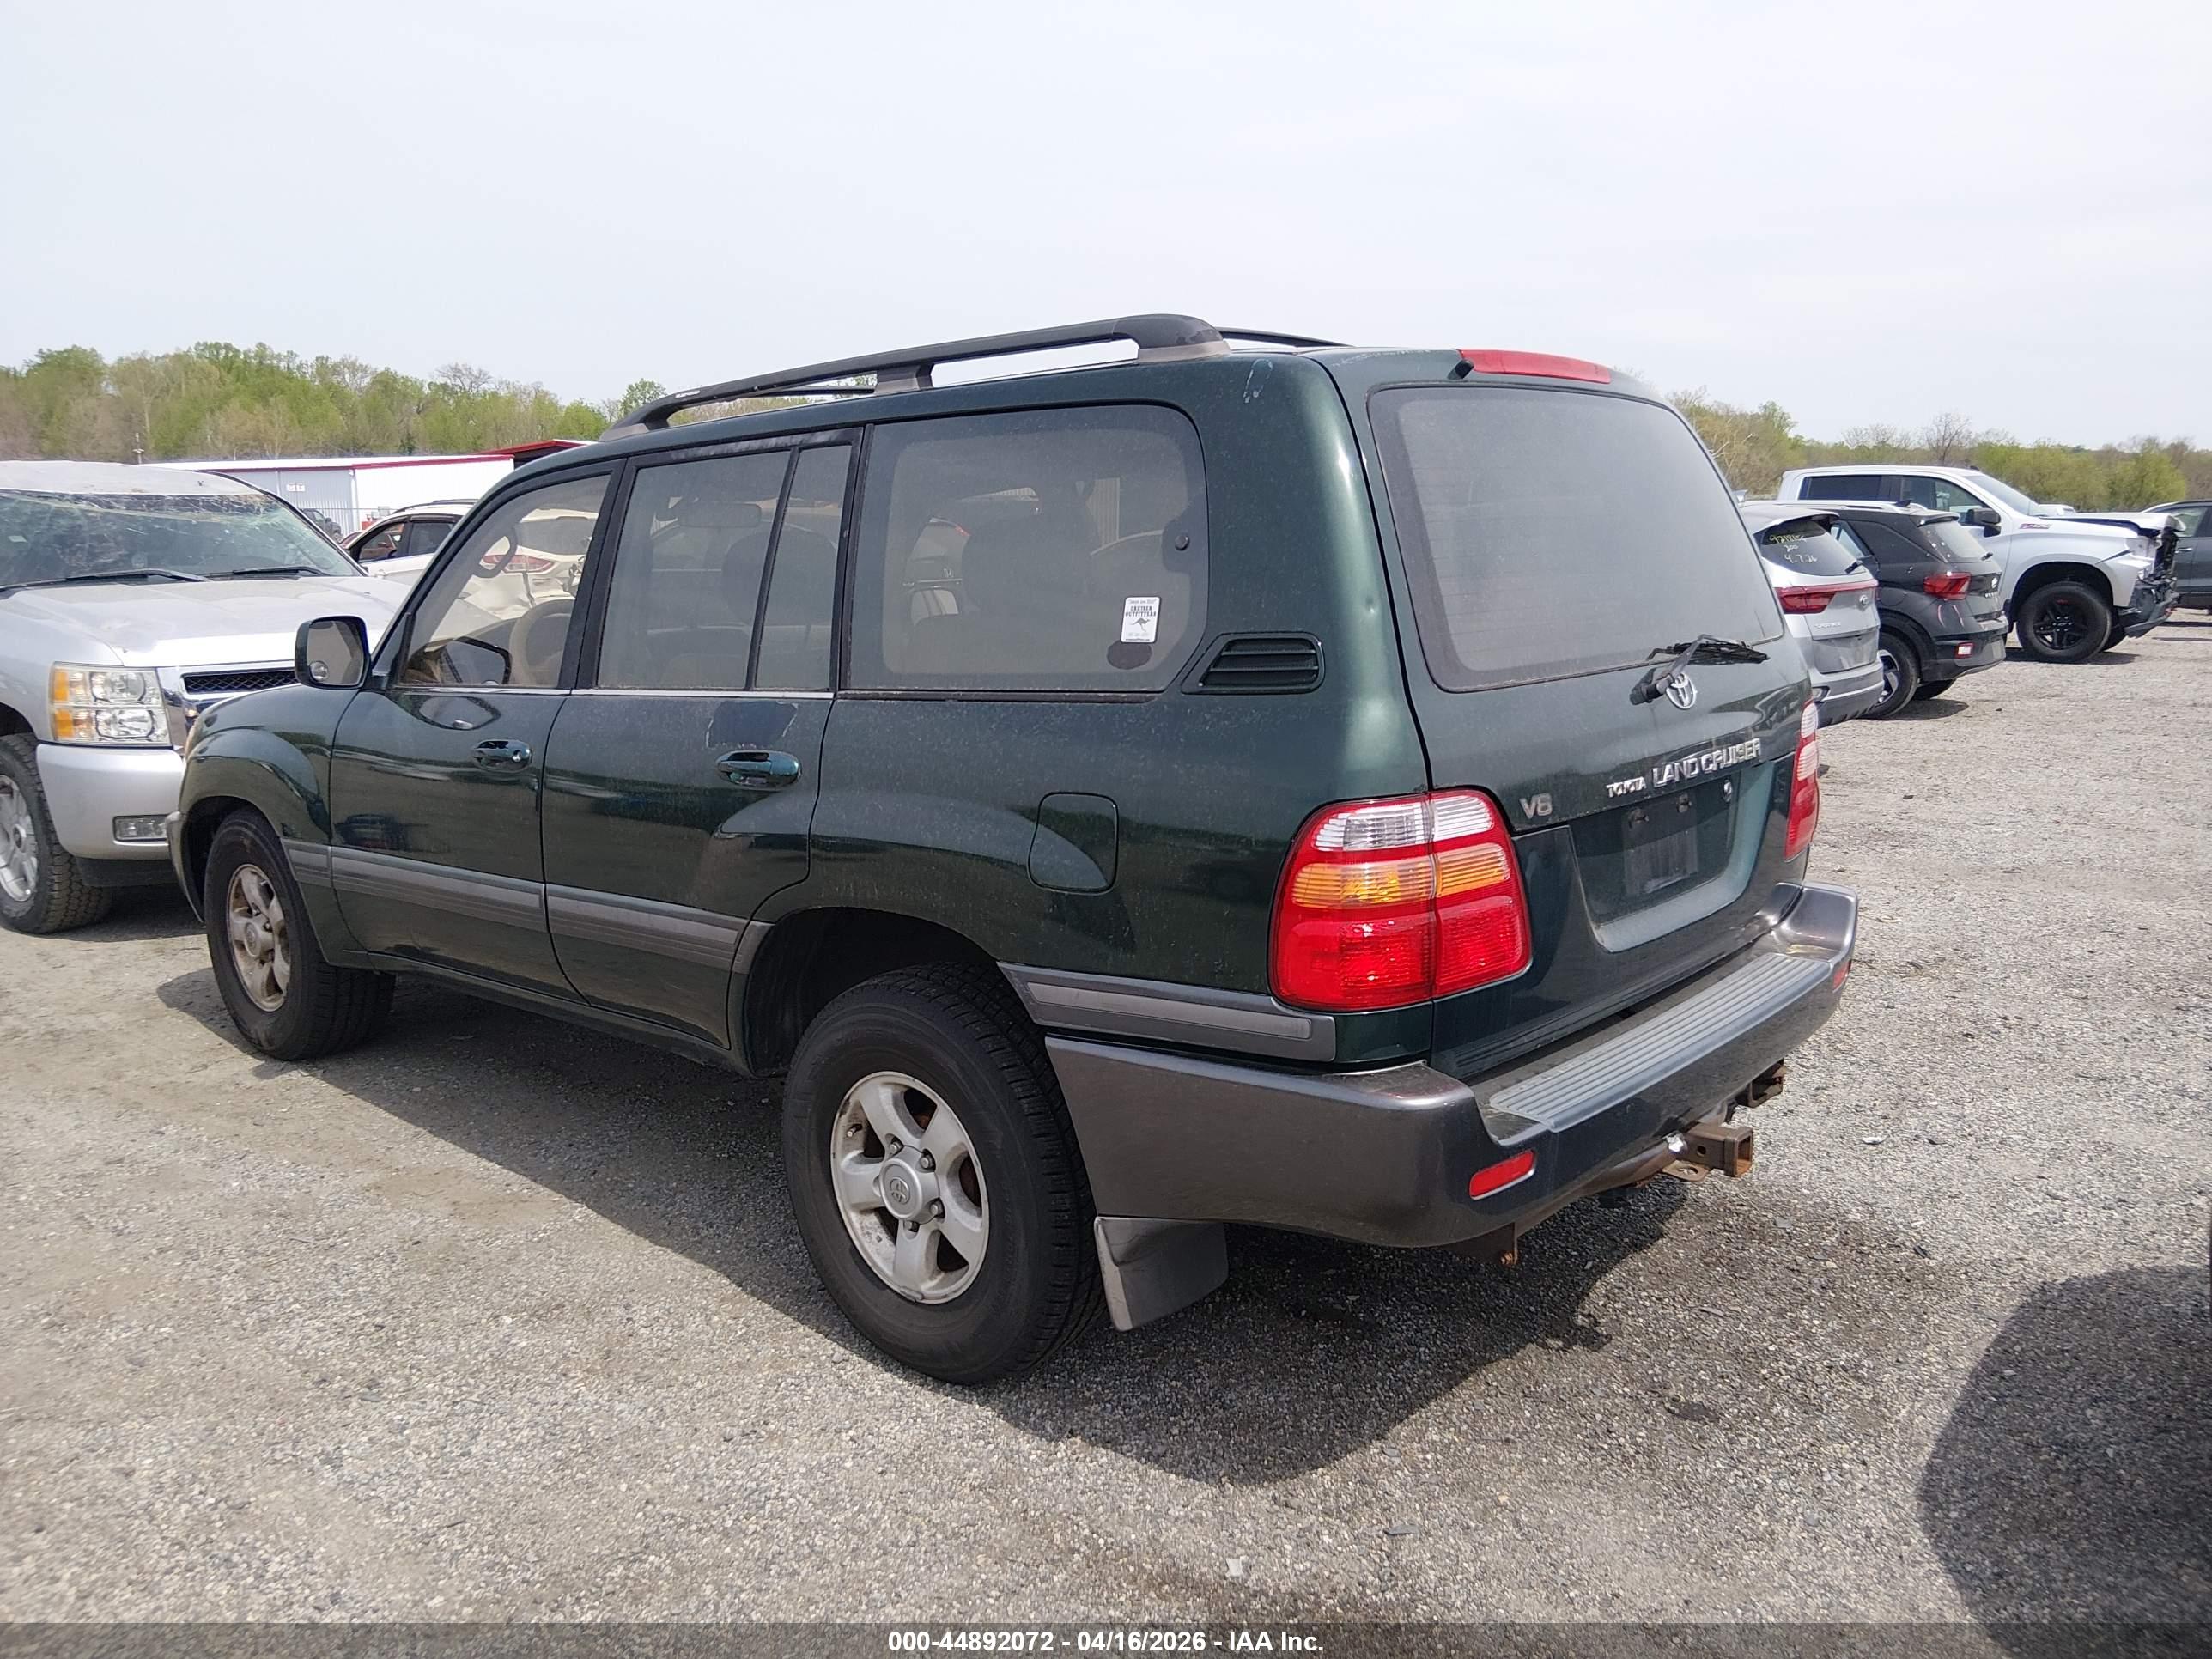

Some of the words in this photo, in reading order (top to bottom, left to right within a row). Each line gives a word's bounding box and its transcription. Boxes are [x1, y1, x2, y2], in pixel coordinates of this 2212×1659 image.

[1652, 758, 1698, 787] LAND
[1701, 738, 1760, 775] CRUISER
[1519, 793, 1553, 818] V8
